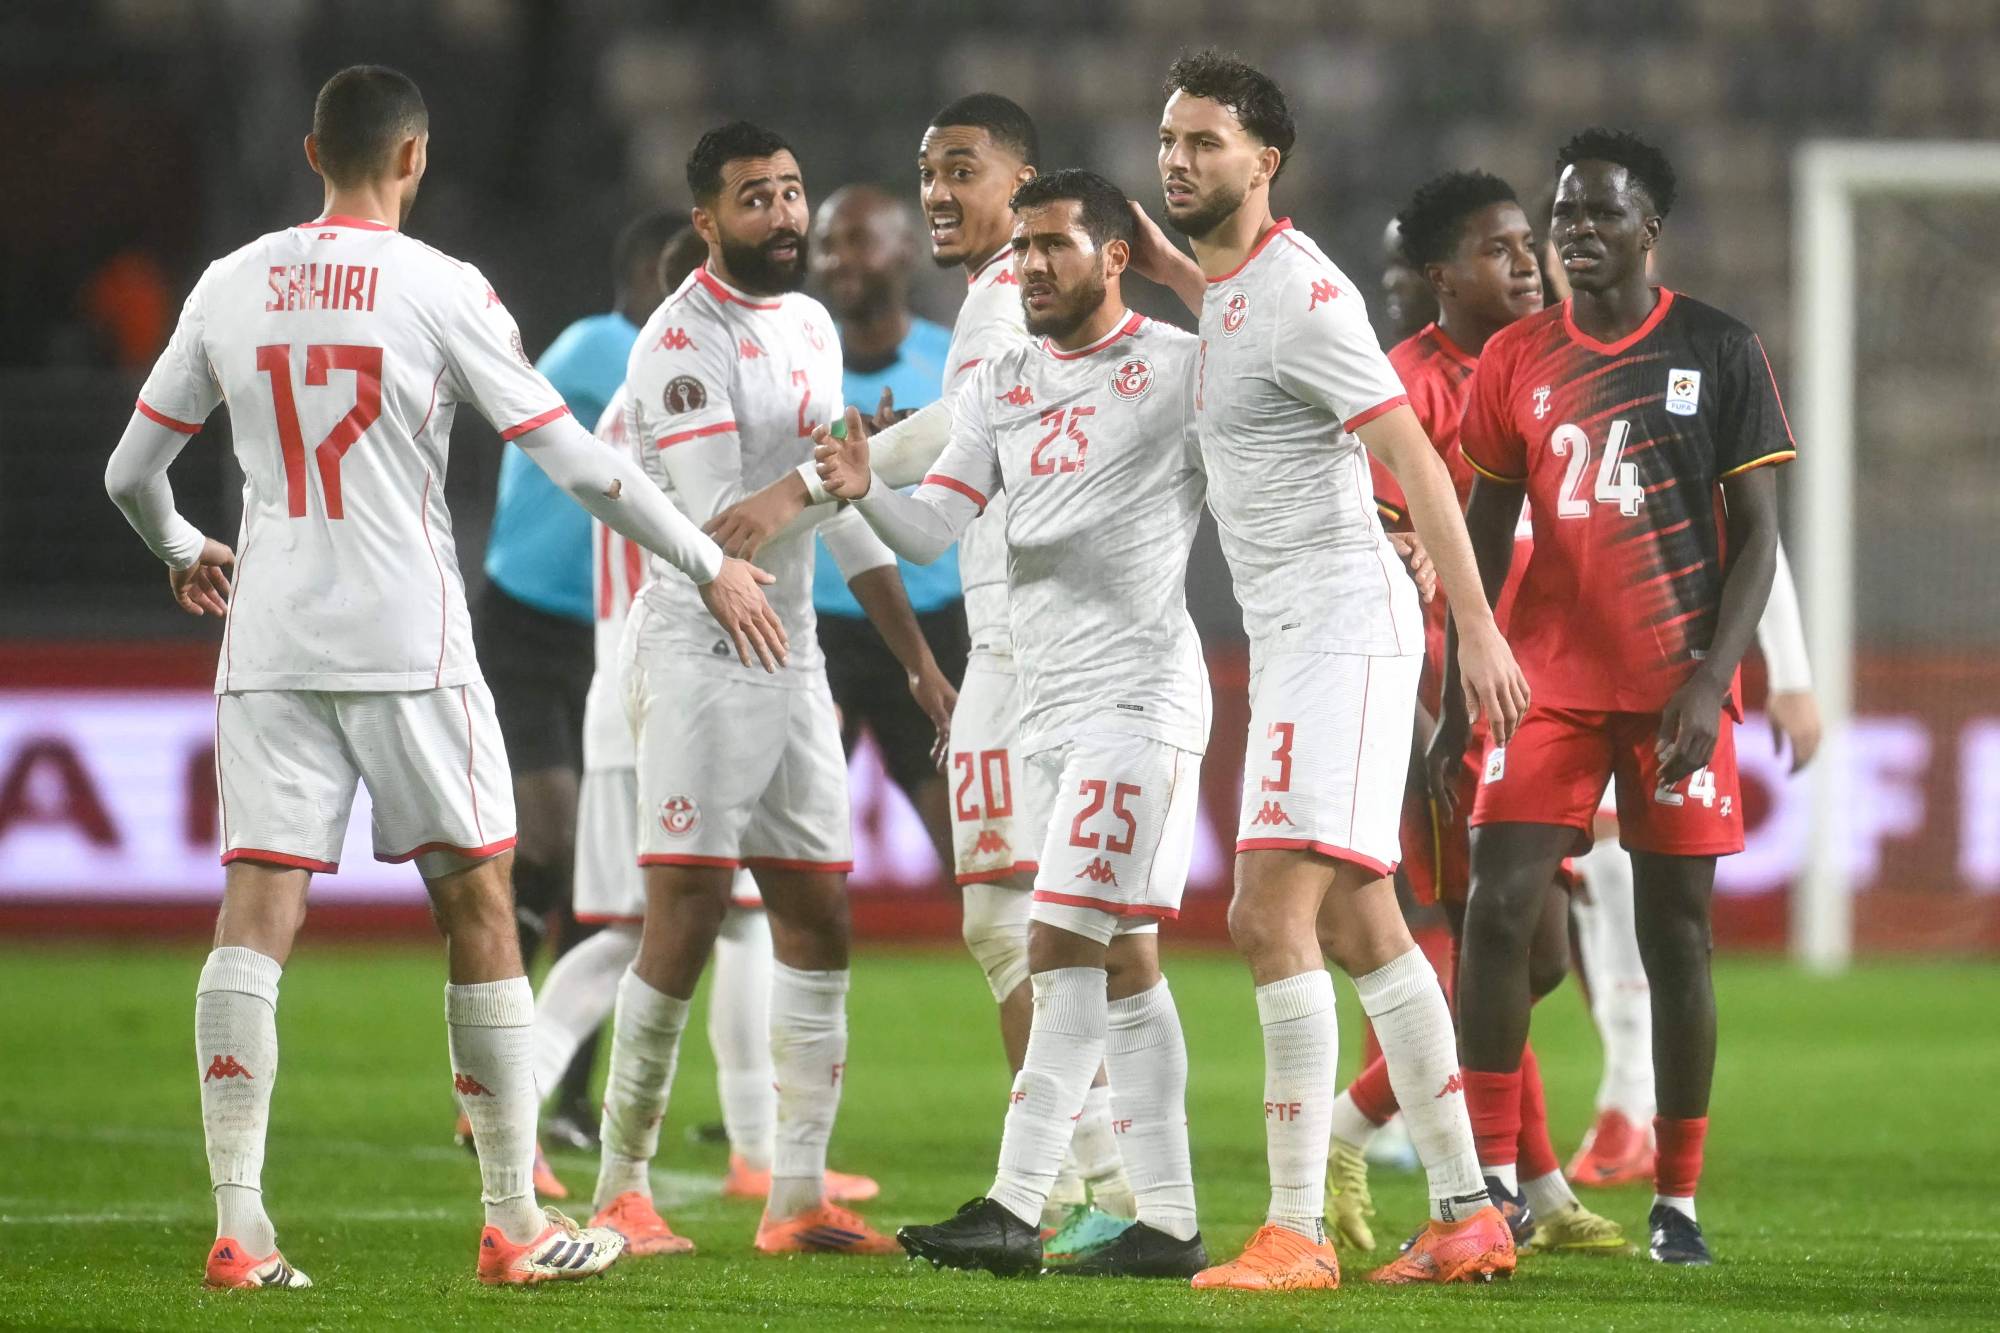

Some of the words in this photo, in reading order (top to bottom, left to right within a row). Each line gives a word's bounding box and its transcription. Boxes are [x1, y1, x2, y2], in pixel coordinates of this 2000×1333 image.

[266, 263, 379, 312] SKHIRI
[256, 344, 383, 519] 17
[792, 369, 816, 437] 2
[1671, 402, 1692, 410] FUFA
[1031, 406, 1096, 476] 25
[1551, 420, 1645, 519] 24
[954, 748, 1013, 822] 20
[1262, 722, 1295, 792] 3
[1069, 779, 1141, 855] 25
[1264, 1102, 1302, 1121] FTF
